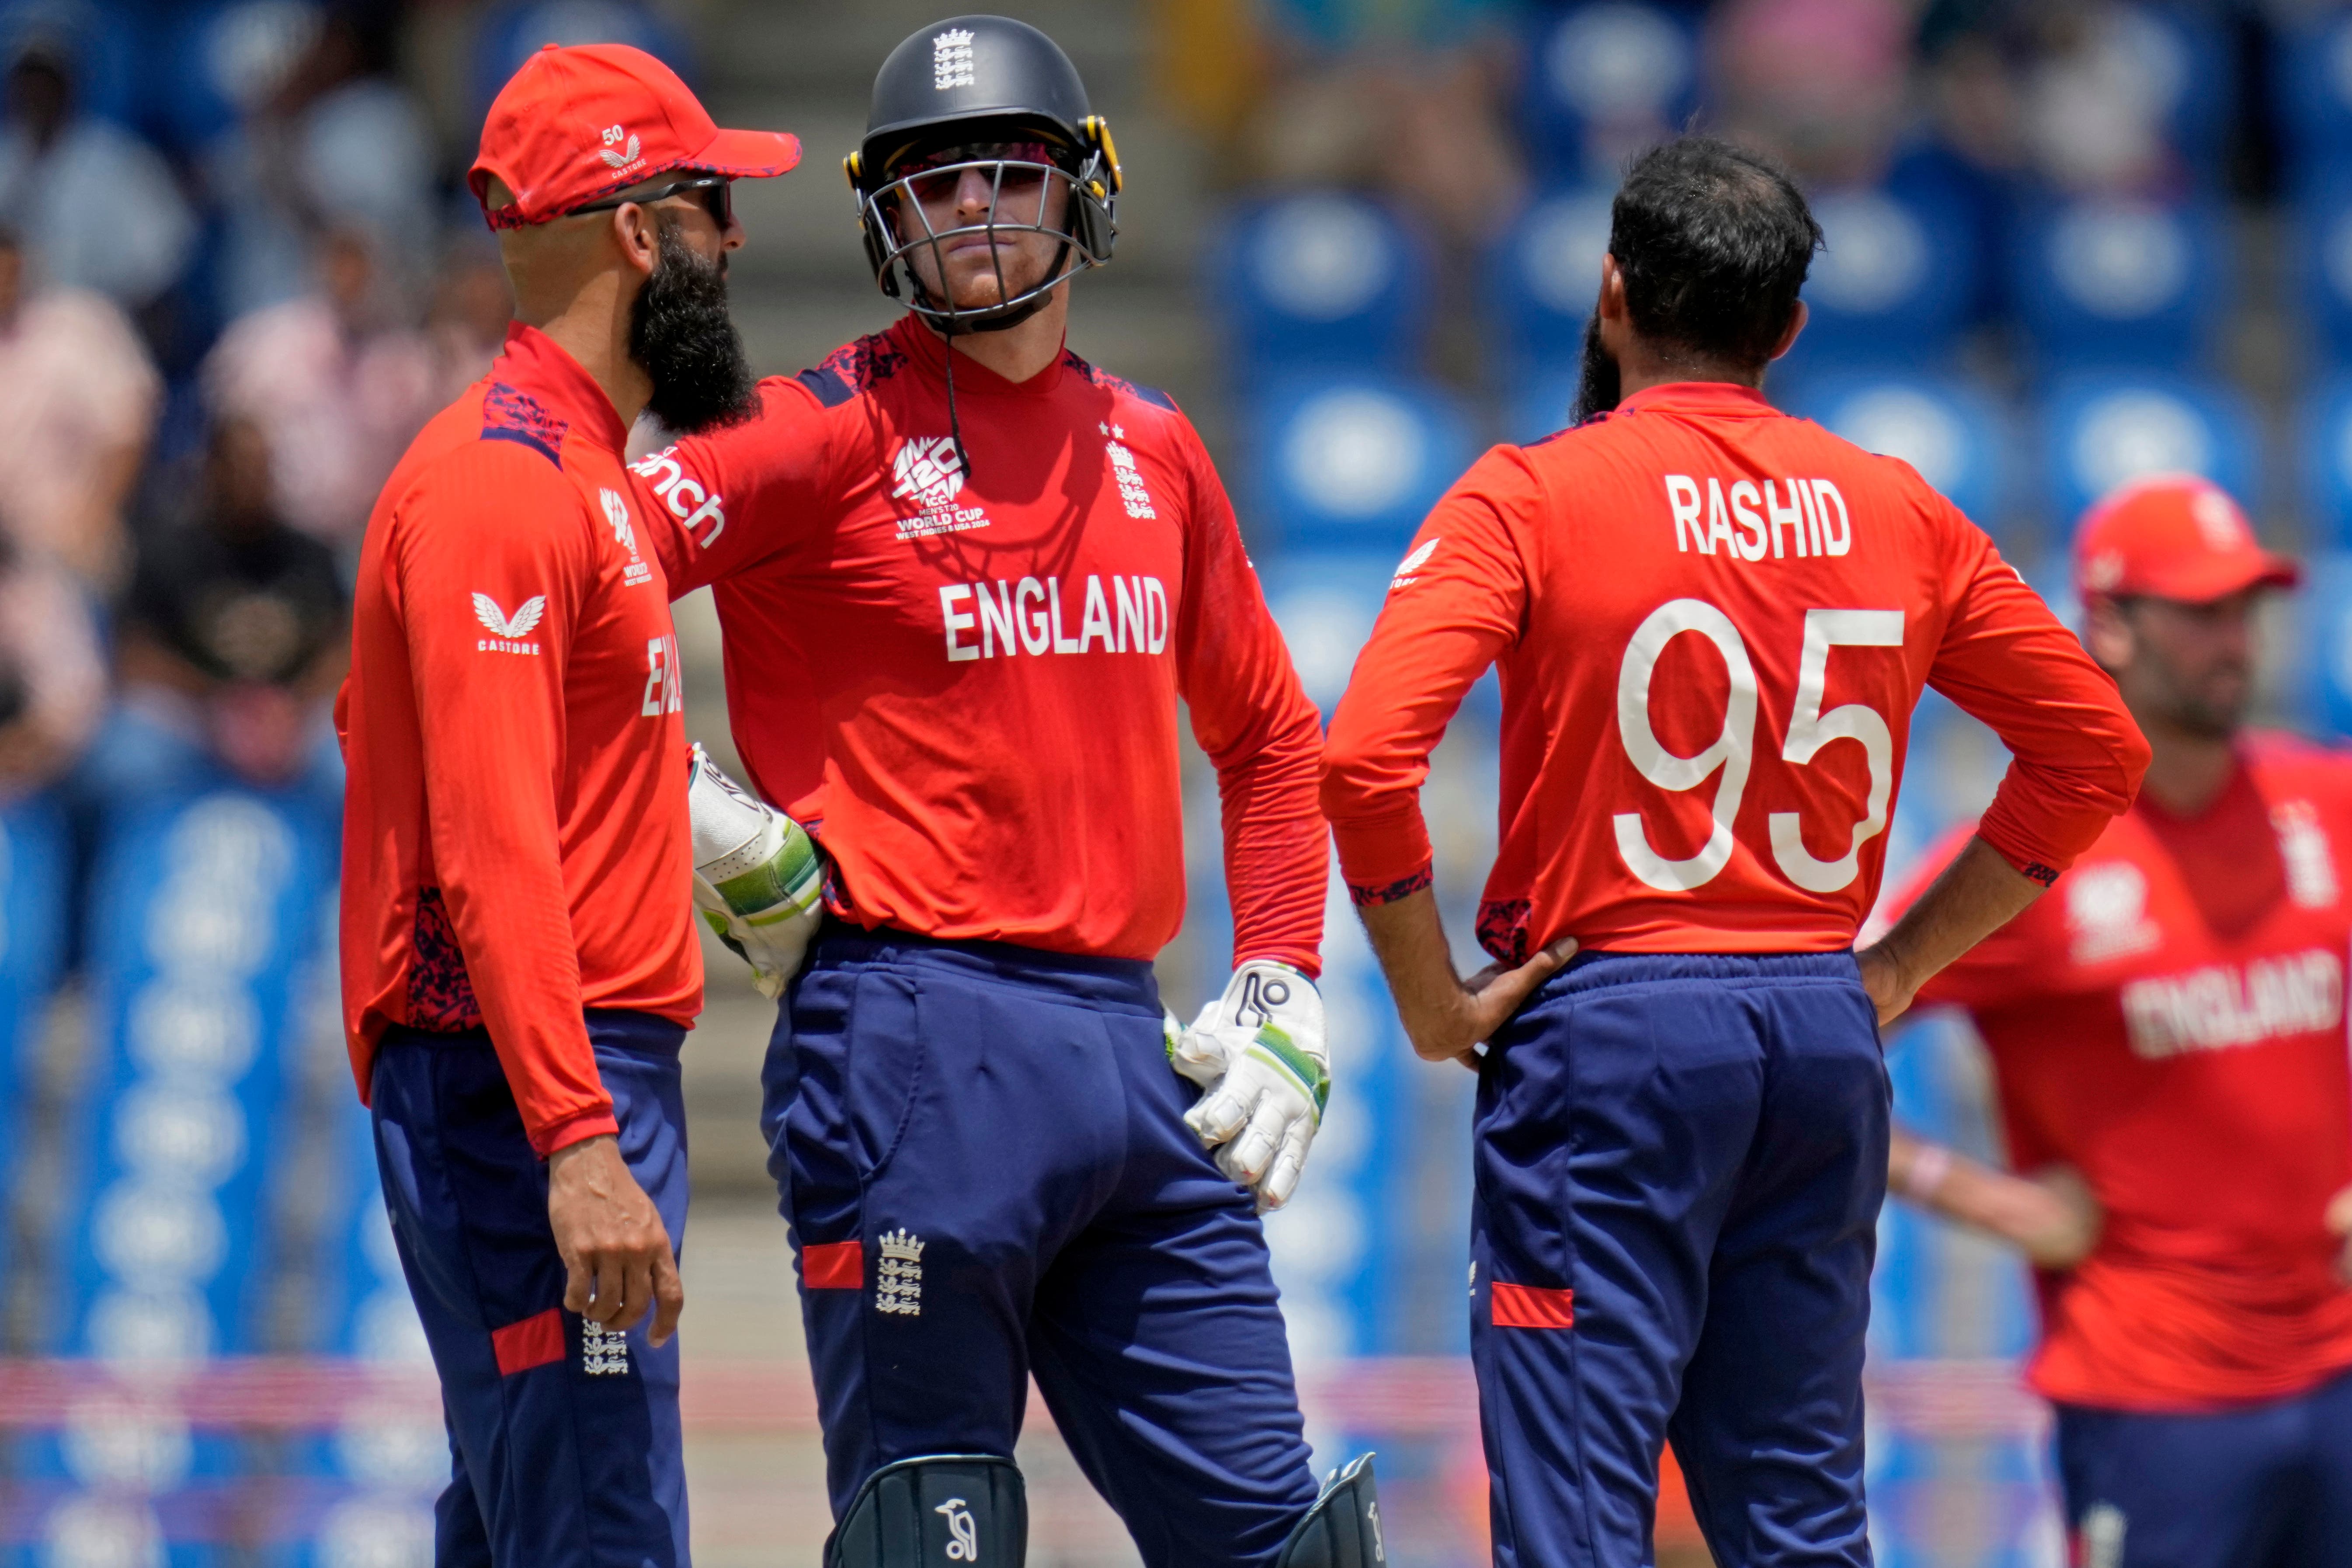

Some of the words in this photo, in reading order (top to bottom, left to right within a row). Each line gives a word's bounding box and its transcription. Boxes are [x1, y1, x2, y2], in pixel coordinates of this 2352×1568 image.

[602, 125, 623, 146] 50
[612, 159, 646, 178] CASTORE
[919, 506, 944, 516] MEN'S
[944, 504, 959, 513] T20
[926, 495, 948, 507] ICC
[896, 513, 953, 532] WORLD
[955, 507, 983, 522] CUP
[1665, 474, 1850, 562] RASHID
[896, 530, 919, 540] WEST
[921, 526, 947, 536] INDIES
[954, 522, 970, 531] USA
[971, 519, 990, 529] 2024
[940, 575, 1168, 662] ENGLAND
[478, 640, 539, 655] CASTORE
[1613, 598, 1904, 892] 95
[2121, 949, 2343, 1059] ENGLAND
